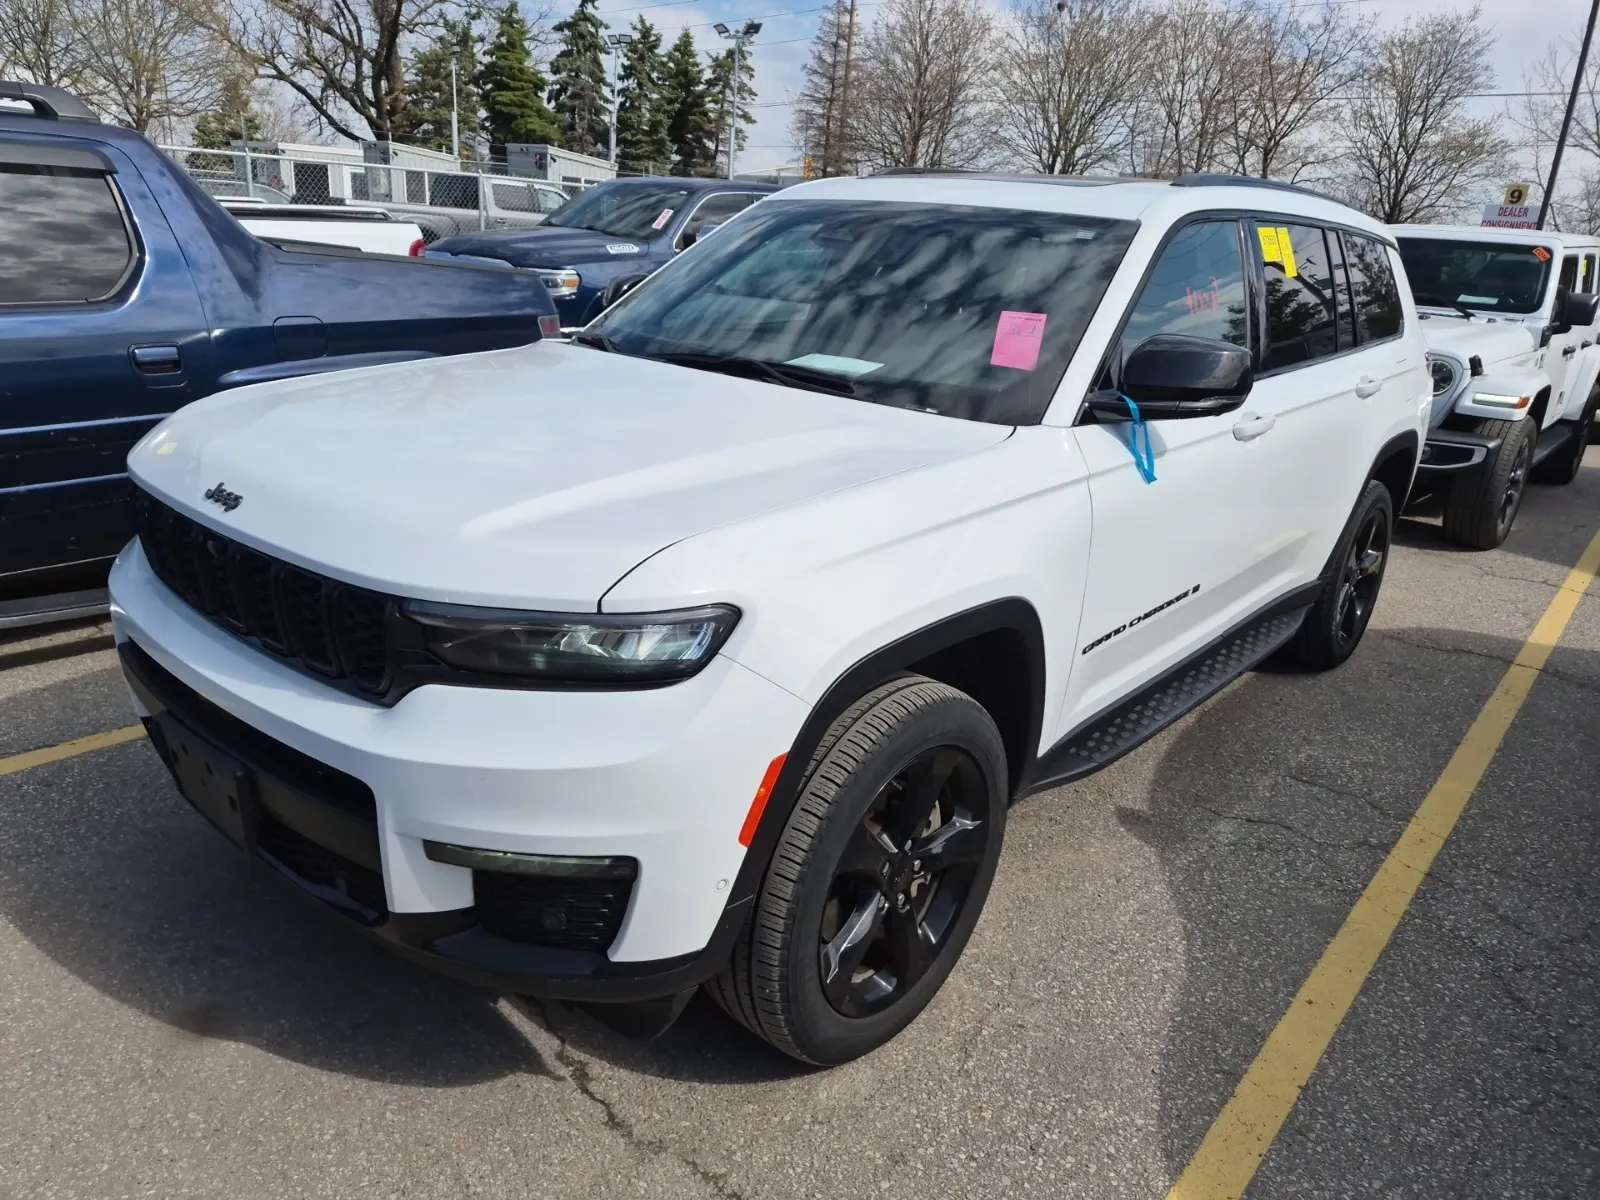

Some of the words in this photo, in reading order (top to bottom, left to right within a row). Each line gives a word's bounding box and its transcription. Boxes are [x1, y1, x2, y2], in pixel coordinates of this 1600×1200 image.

[1509, 188, 1523, 204] 9
[1498, 206, 1529, 218] DEALER
[1481, 220, 1538, 230] CONSIGNMENT
[205, 482, 243, 512] Jeep
[1081, 624, 1127, 655] GRAND
[1128, 589, 1190, 628] CHEROKEE
